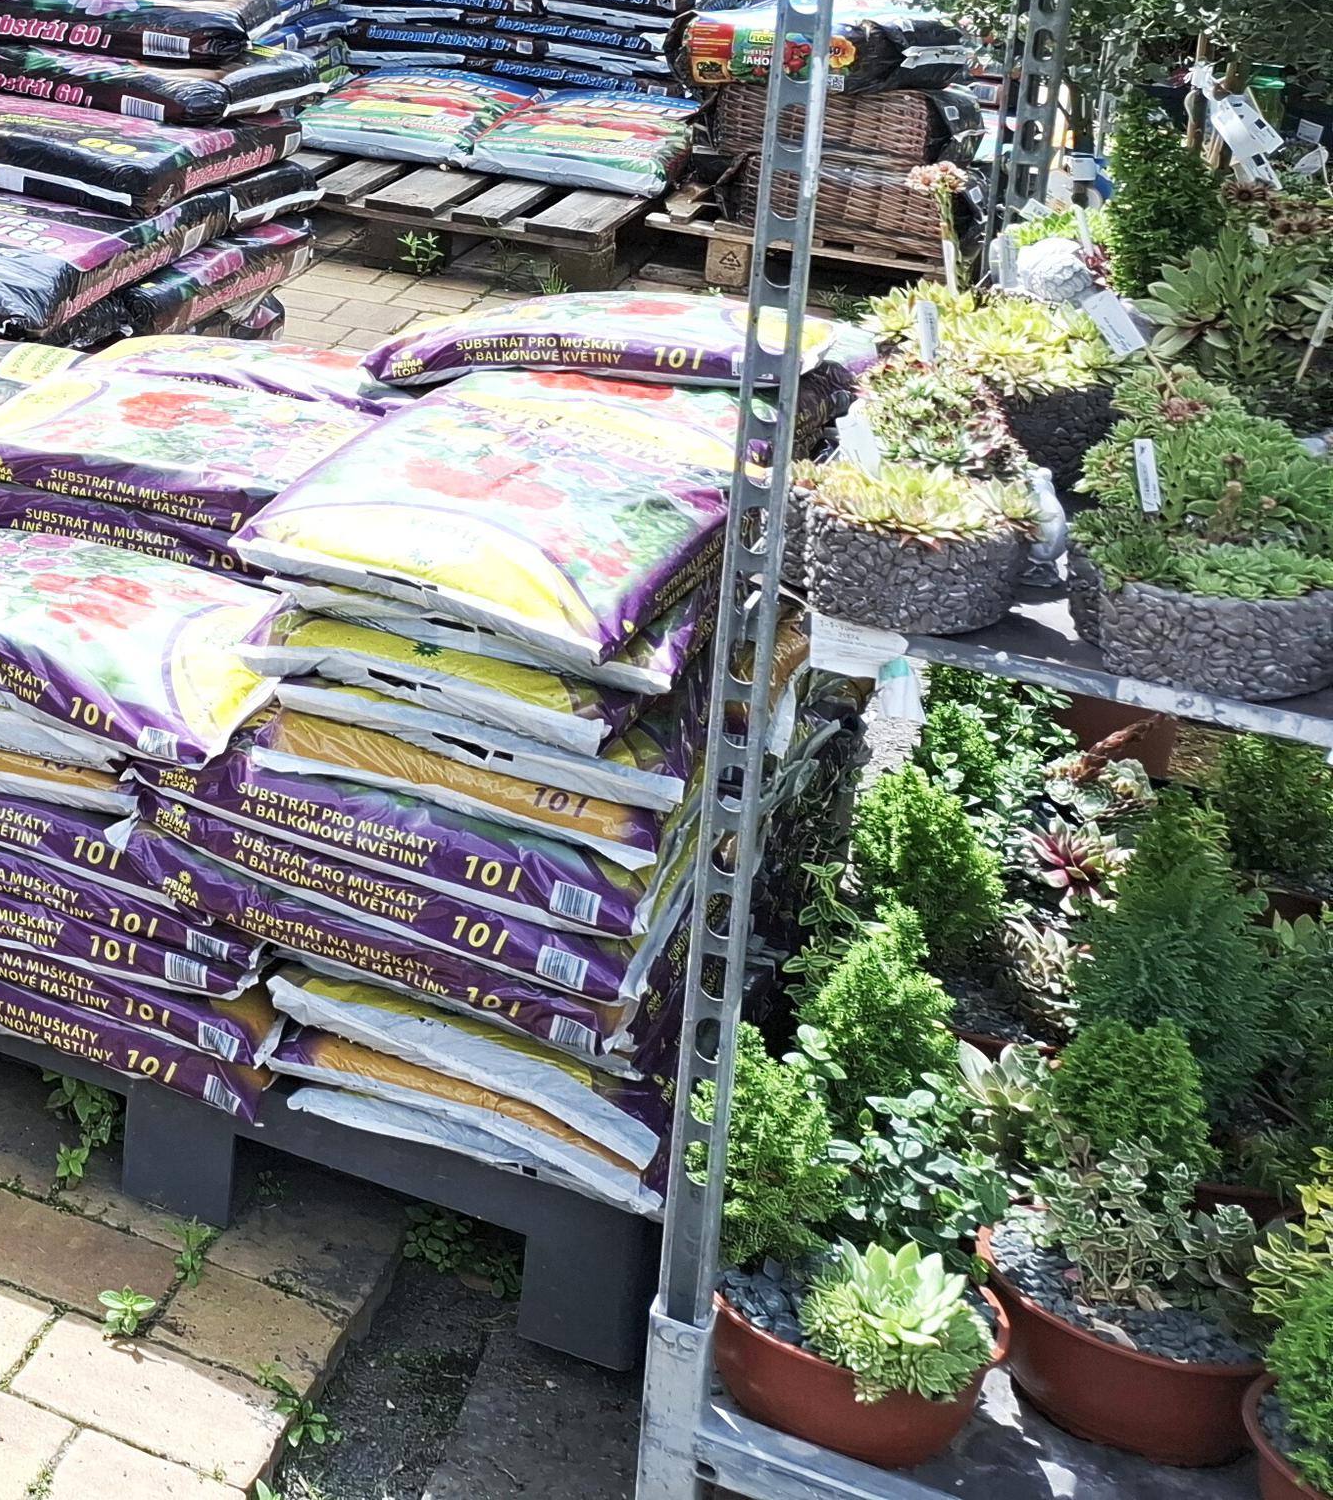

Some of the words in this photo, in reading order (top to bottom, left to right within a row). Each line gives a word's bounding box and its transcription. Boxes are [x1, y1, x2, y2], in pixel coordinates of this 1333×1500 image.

[69, 23, 99, 47] 60
[158, 770, 198, 786] PRIMA
[158, 778, 197, 794] FLORA
[237, 782, 318, 815] SUBSTRÁT
[321, 805, 355, 827] PRO
[357, 815, 437, 853] MUŠKÁTY
[241, 800, 253, 815] A
[255, 804, 352, 846] BALKÓNOVÉ
[354, 833, 428, 868] KVĚTINY
[463, 854, 503, 887] 10
[8, 874, 79, 903] MUŠKÁTY
[109, 908, 141, 934] 10
